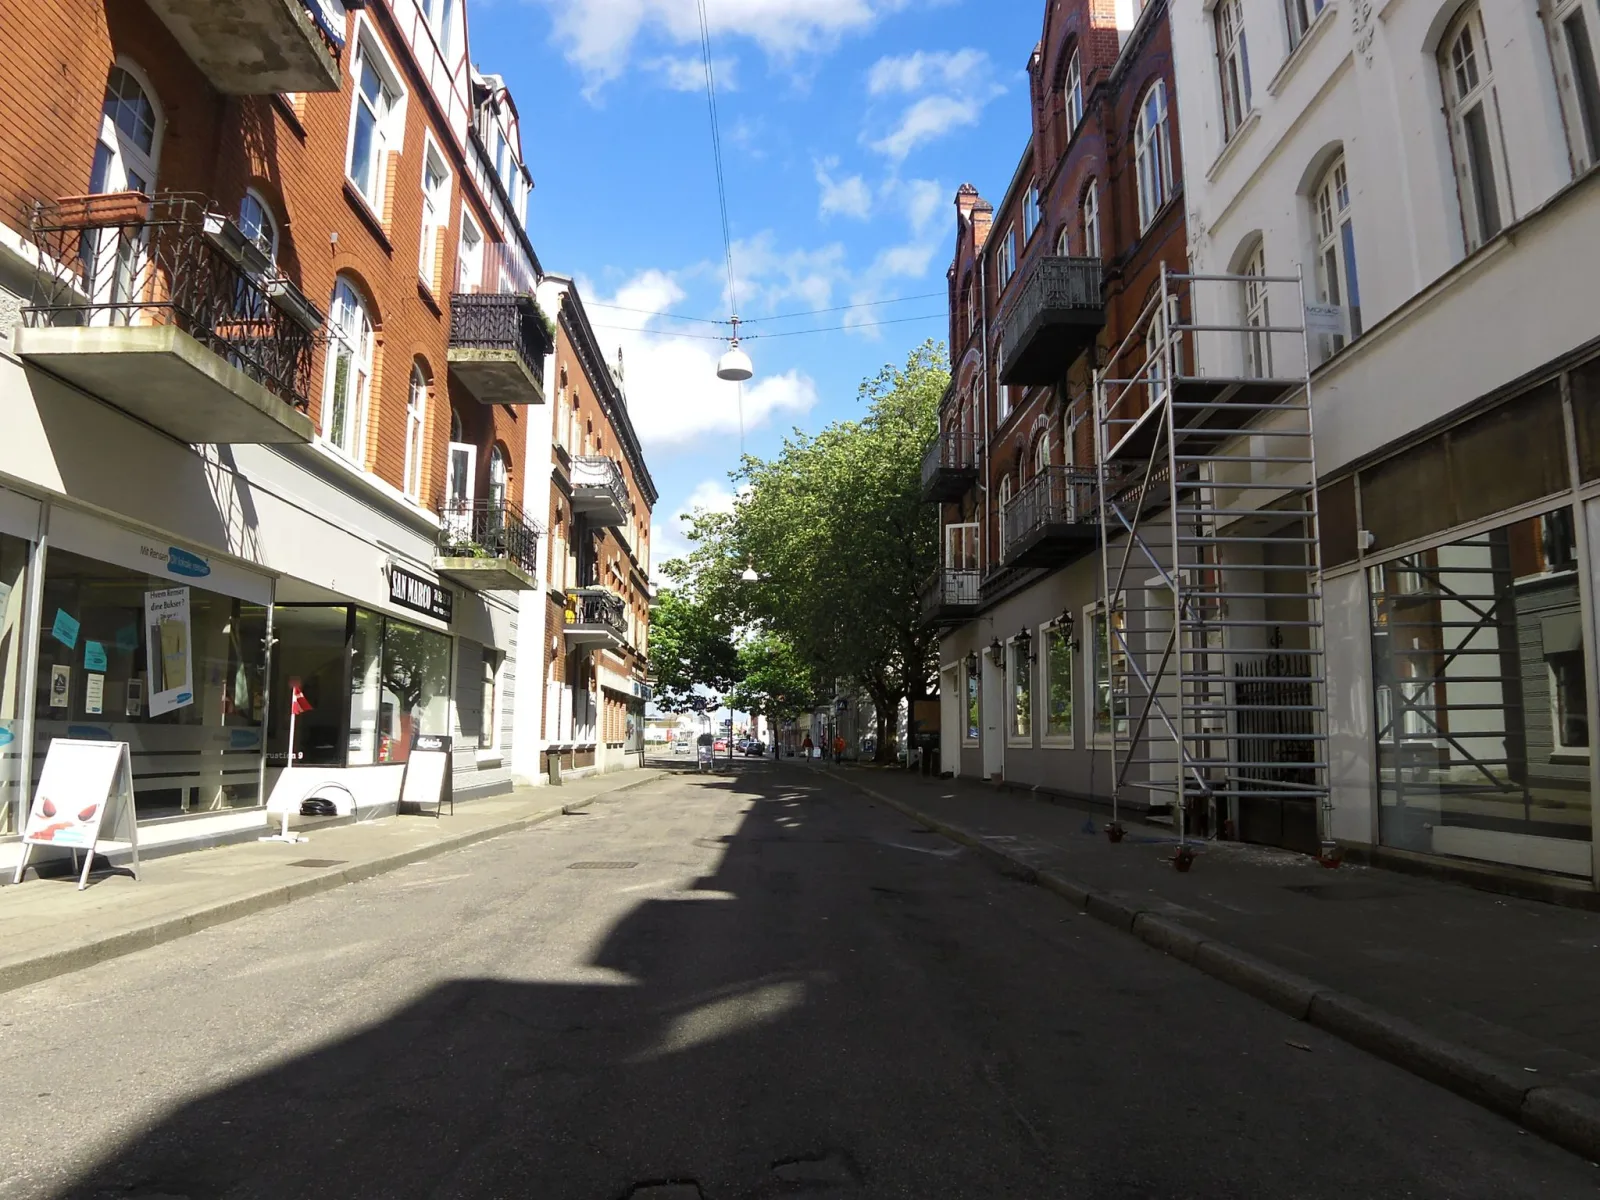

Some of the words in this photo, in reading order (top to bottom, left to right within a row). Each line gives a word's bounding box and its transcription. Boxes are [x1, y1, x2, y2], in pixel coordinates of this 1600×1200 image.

[392, 570, 407, 600] SAN
[407, 577, 431, 609] MARCO
[298, 751, 304, 759] 9
